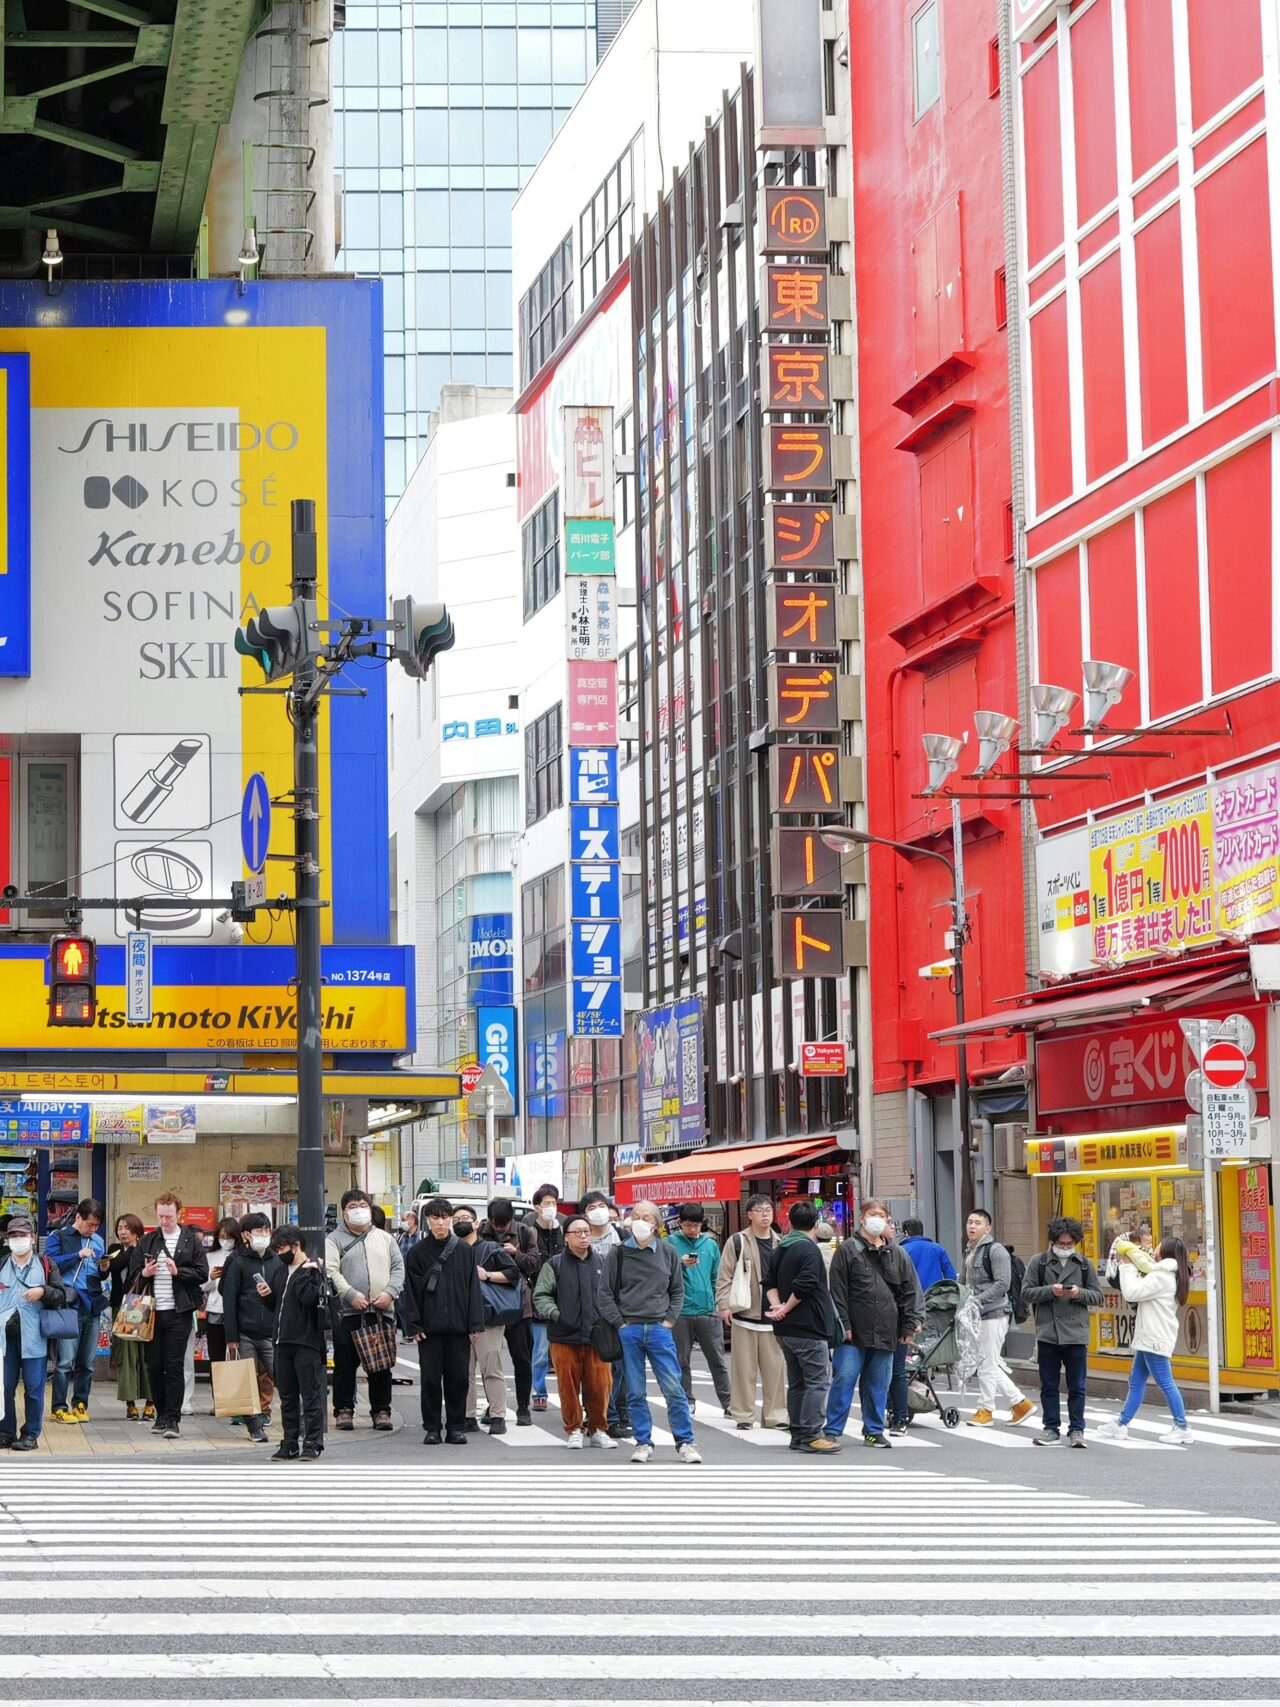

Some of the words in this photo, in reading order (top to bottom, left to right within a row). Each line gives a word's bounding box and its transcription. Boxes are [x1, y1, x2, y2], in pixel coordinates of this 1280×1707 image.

[58, 418, 299, 454] SHISEIDO
[162, 473, 278, 508] KOSÉ
[87, 528, 272, 568] Kanebo
[570, 533, 610, 545] 西川電子
[570, 550, 611, 561] パーツ部
[103, 590, 261, 622] SOFINA
[596, 581, 611, 647] 森事務所
[772, 271, 836, 971] 東京ラジオデパート
[138, 641, 229, 680] SK-II
[577, 677, 608, 688] 真空管
[577, 694, 608, 705] 専門店
[1215, 776, 1277, 820] ギフトカード
[1217, 825, 1279, 867] プリペイドカード
[1047, 870, 1081, 896] スポーツくじ
[1103, 847, 1144, 919] 1億円
[1075, 902, 1088, 917] BIG
[477, 927, 507, 939] Models
[131, 939, 147, 967] 夜間
[134, 969, 145, 1016] 押ボタン式
[46, 1006, 231, 1029] tsmoto
[237, 1006, 356, 1029] KiYhi
[576, 1018, 619, 1026] カードゲーム
[206, 1037, 256, 1049] この看板は
[258, 1038, 279, 1048] LED
[280, 1037, 394, 1049] 照明用しております。
[485, 1022, 510, 1098] GiG
[1109, 1030, 1176, 1098] 宝くじ
[1207, 1093, 1245, 1101] 自転車を除く
[1208, 1104, 1233, 1112] 日曜の
[632, 1183, 646, 1201] TOKYO
[648, 1182, 663, 1200] RADIO
[664, 1179, 697, 1199] DEPARTMENT
[698, 1178, 716, 1198] STORE
